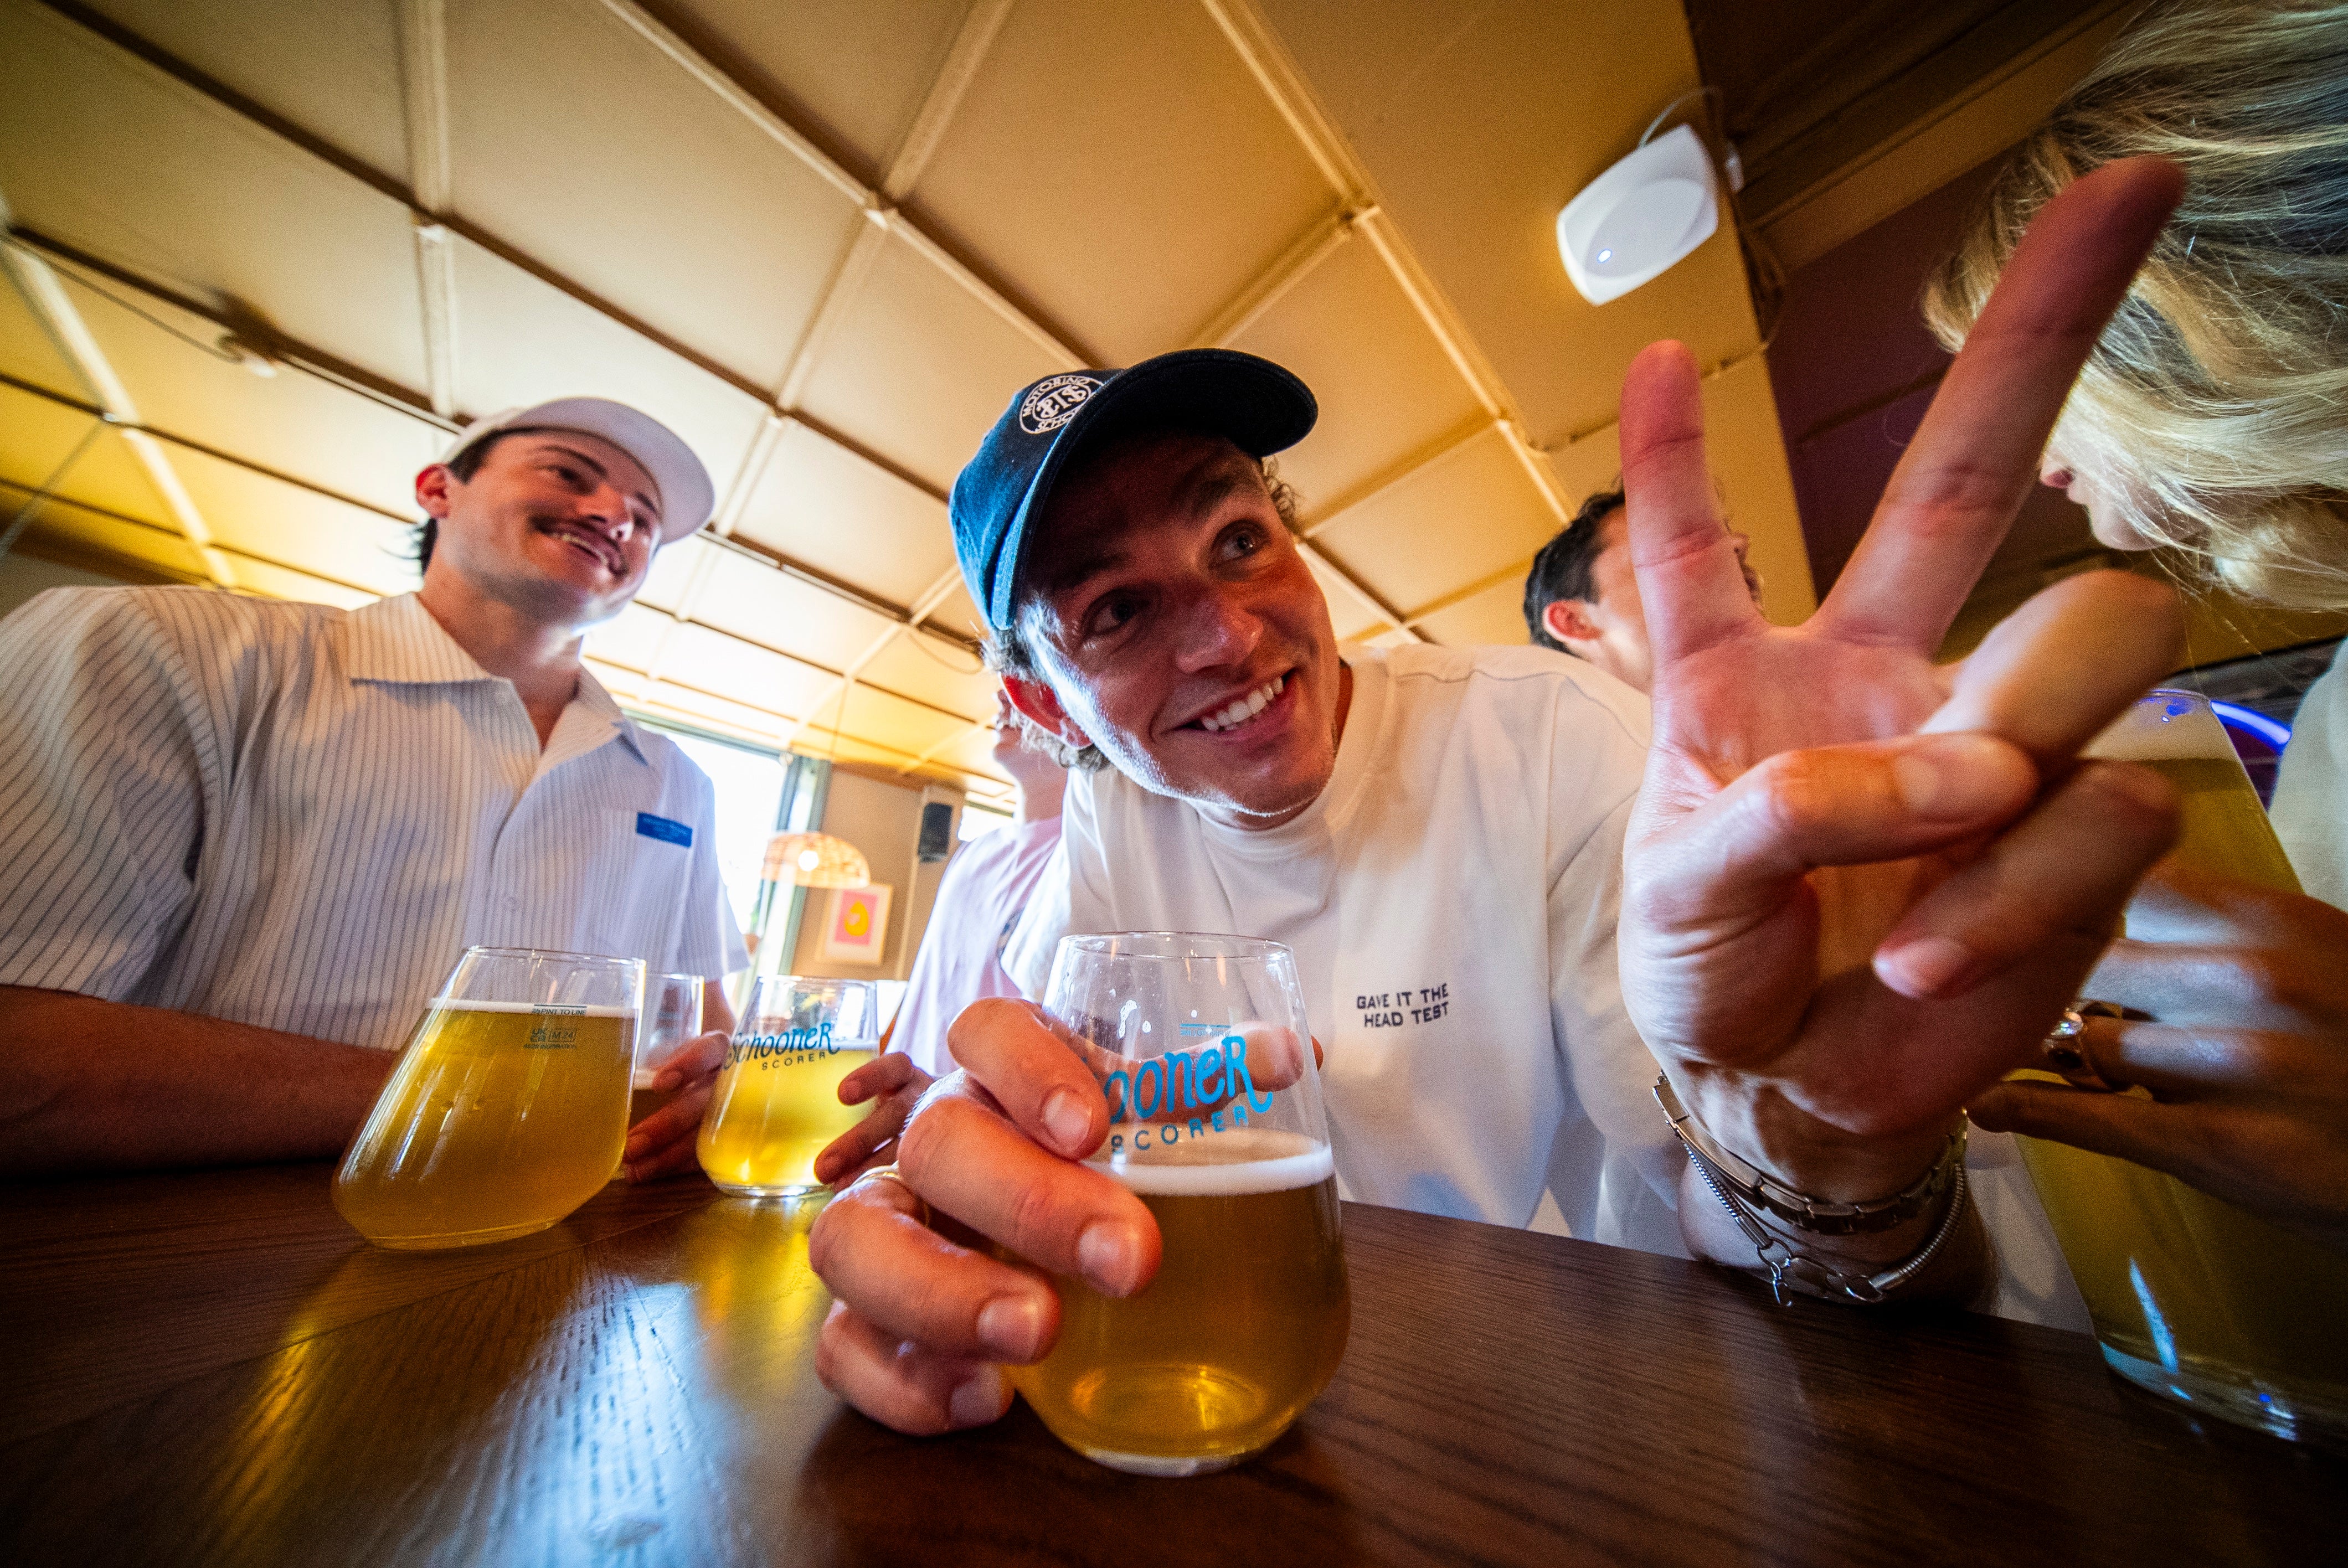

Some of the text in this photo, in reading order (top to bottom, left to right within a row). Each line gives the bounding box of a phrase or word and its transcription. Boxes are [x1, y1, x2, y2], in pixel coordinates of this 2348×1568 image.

[1397, 991, 1412, 1007] IT
[1420, 983, 1449, 1003] THE
[1364, 1001, 1449, 1028] HEAD TEST
[762, 1051, 825, 1071] SCORER
